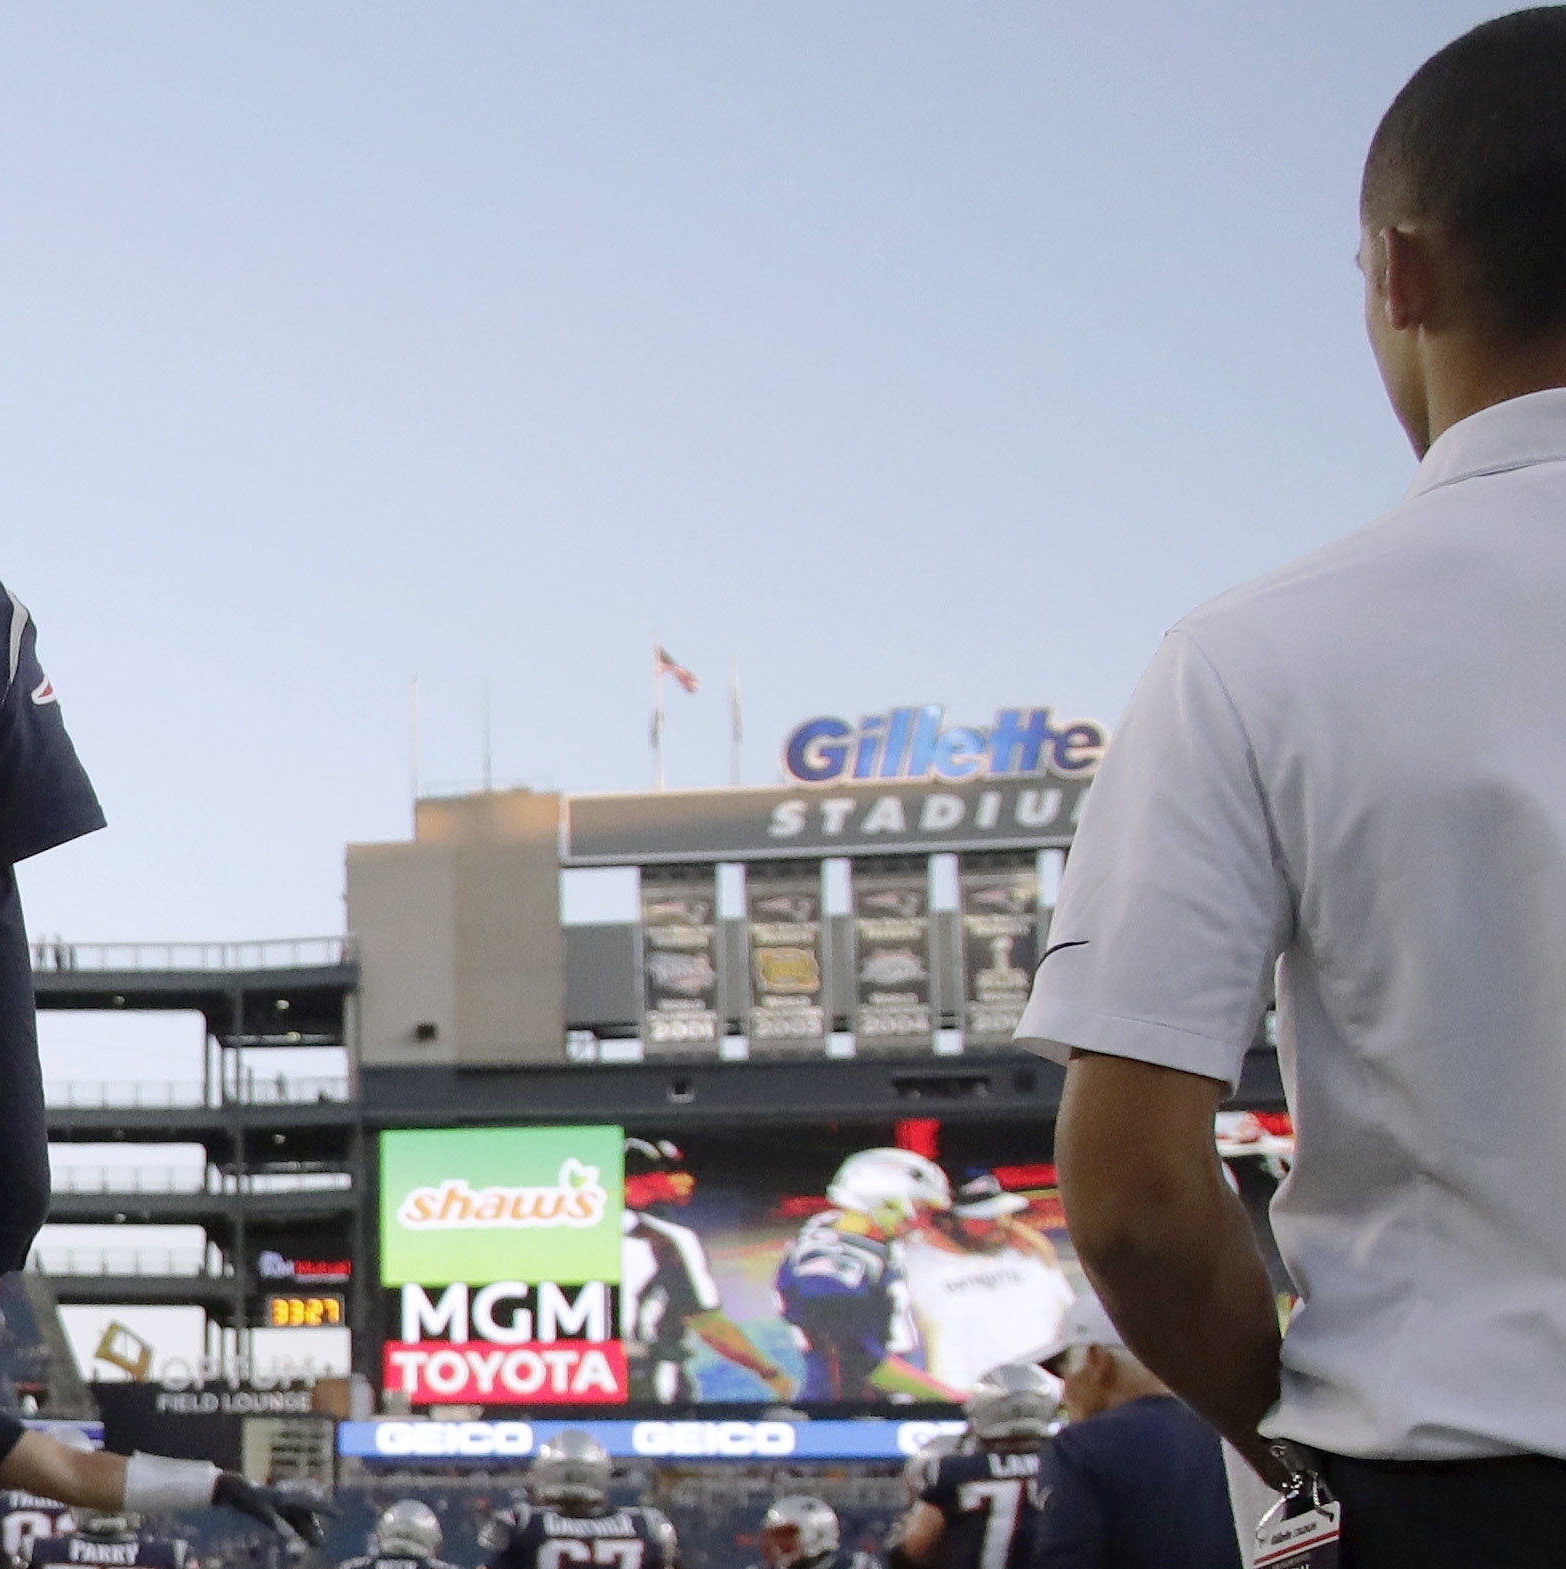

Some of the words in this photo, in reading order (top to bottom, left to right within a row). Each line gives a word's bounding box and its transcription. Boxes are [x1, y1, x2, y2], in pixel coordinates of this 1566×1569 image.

[785, 704, 1102, 783] Gillette
[768, 786, 1091, 838] STADIU
[401, 1281, 611, 1343] MGM
[390, 1349, 619, 1394] TOYOTA
[156, 1391, 218, 1412] FIELD
[220, 1390, 311, 1413] LOUNGE
[376, 1421, 533, 1456] GEICO
[632, 1420, 796, 1456] GEICO
